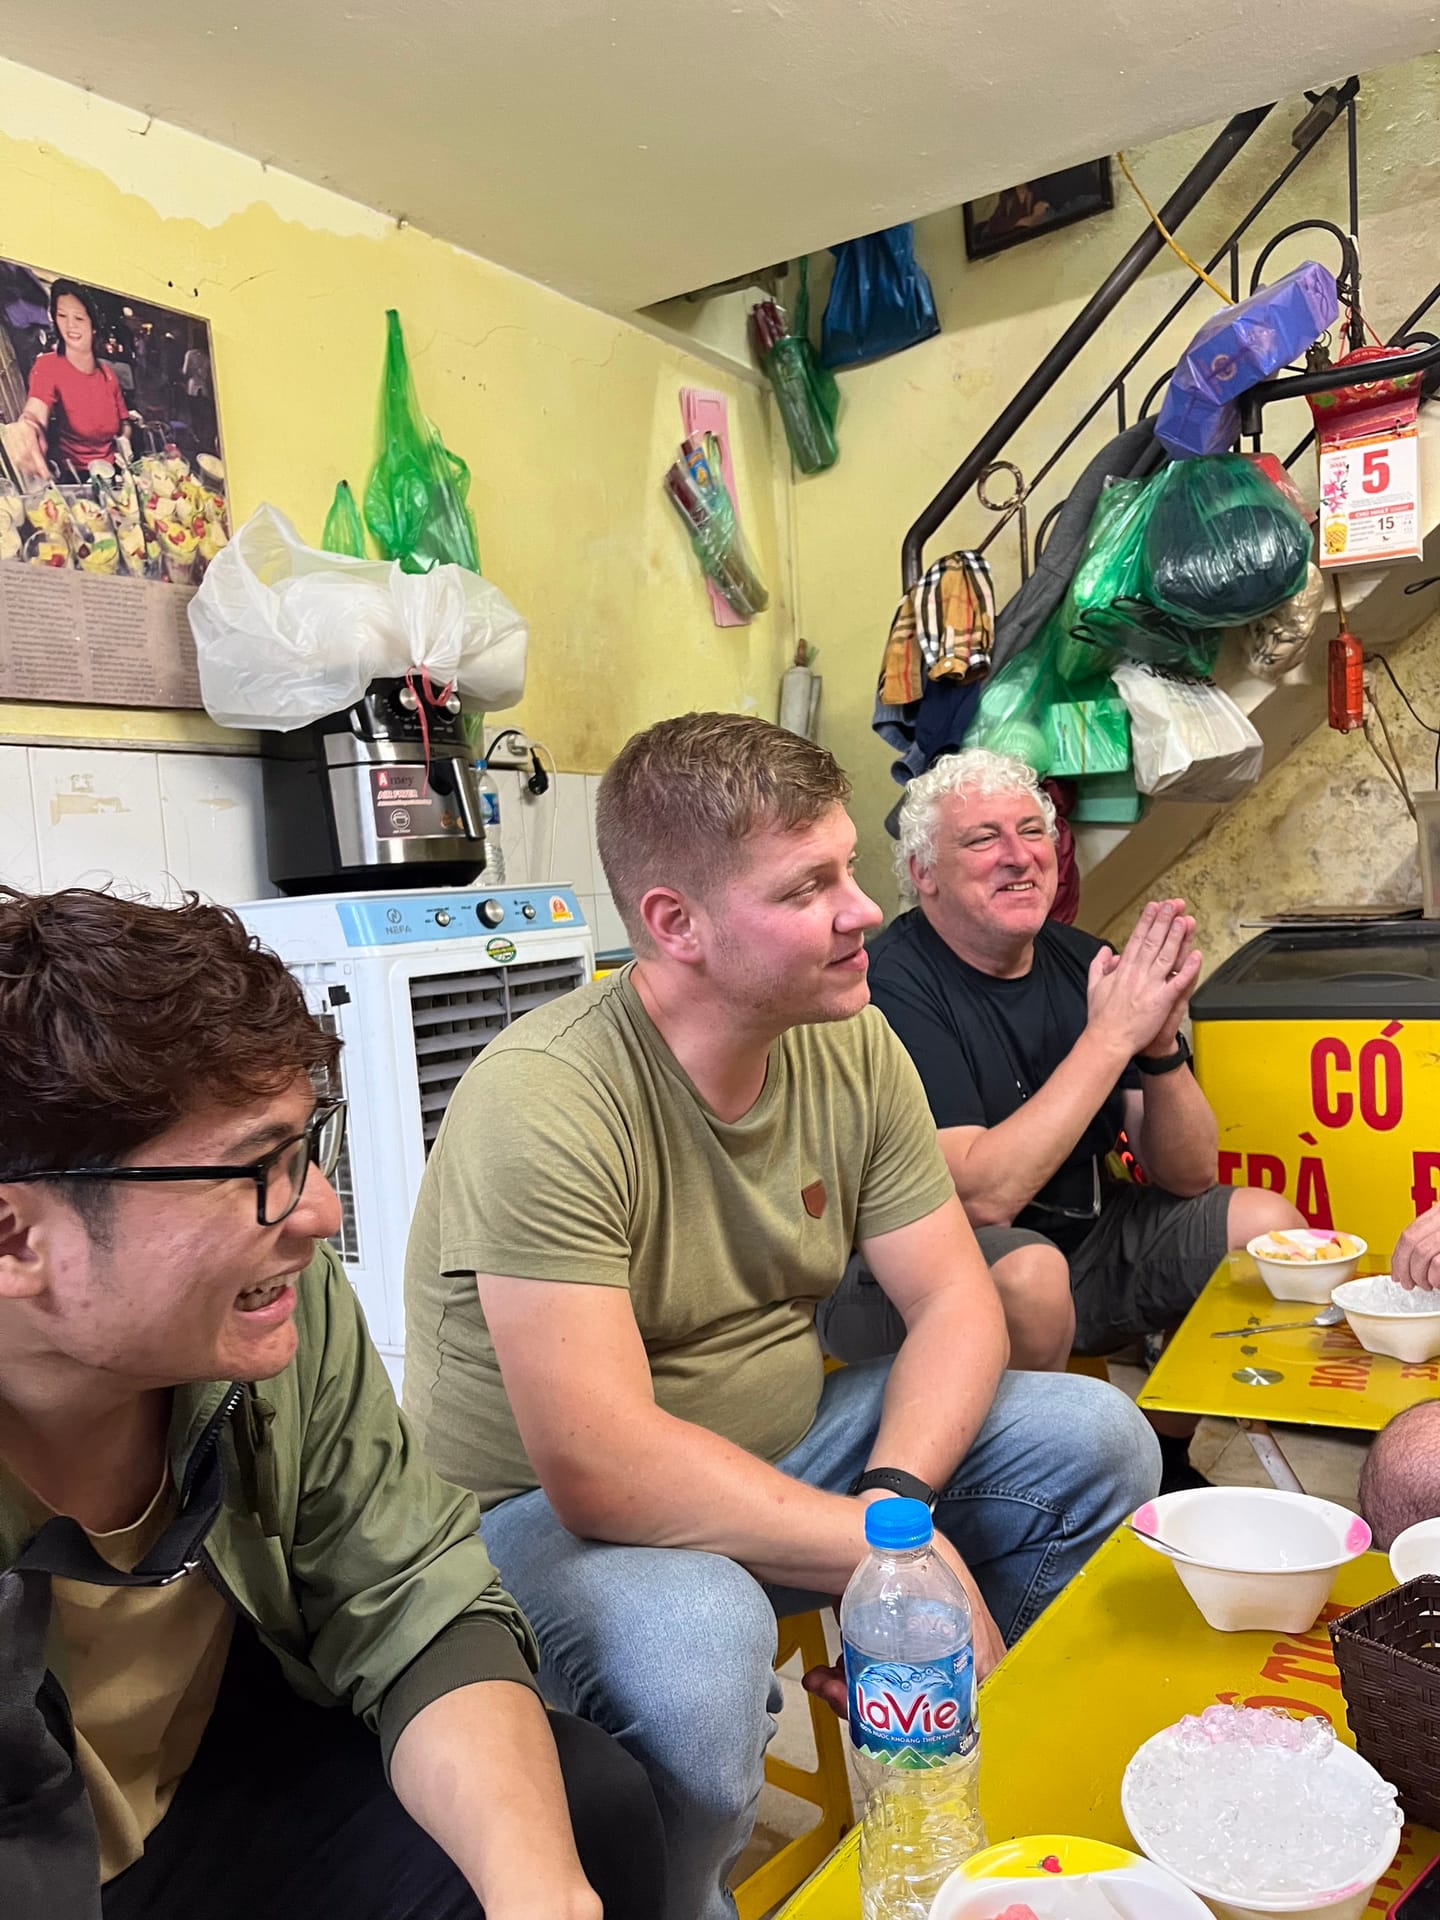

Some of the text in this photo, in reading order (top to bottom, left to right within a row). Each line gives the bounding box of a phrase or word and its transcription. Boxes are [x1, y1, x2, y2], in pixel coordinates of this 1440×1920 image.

[1362, 449, 1390, 494] 5
[1377, 516, 1395, 531] 15
[385, 926, 412, 936] NEFA
[1311, 1020, 1403, 1131] CÓ
[1309, 1355, 1373, 1391] HOA
